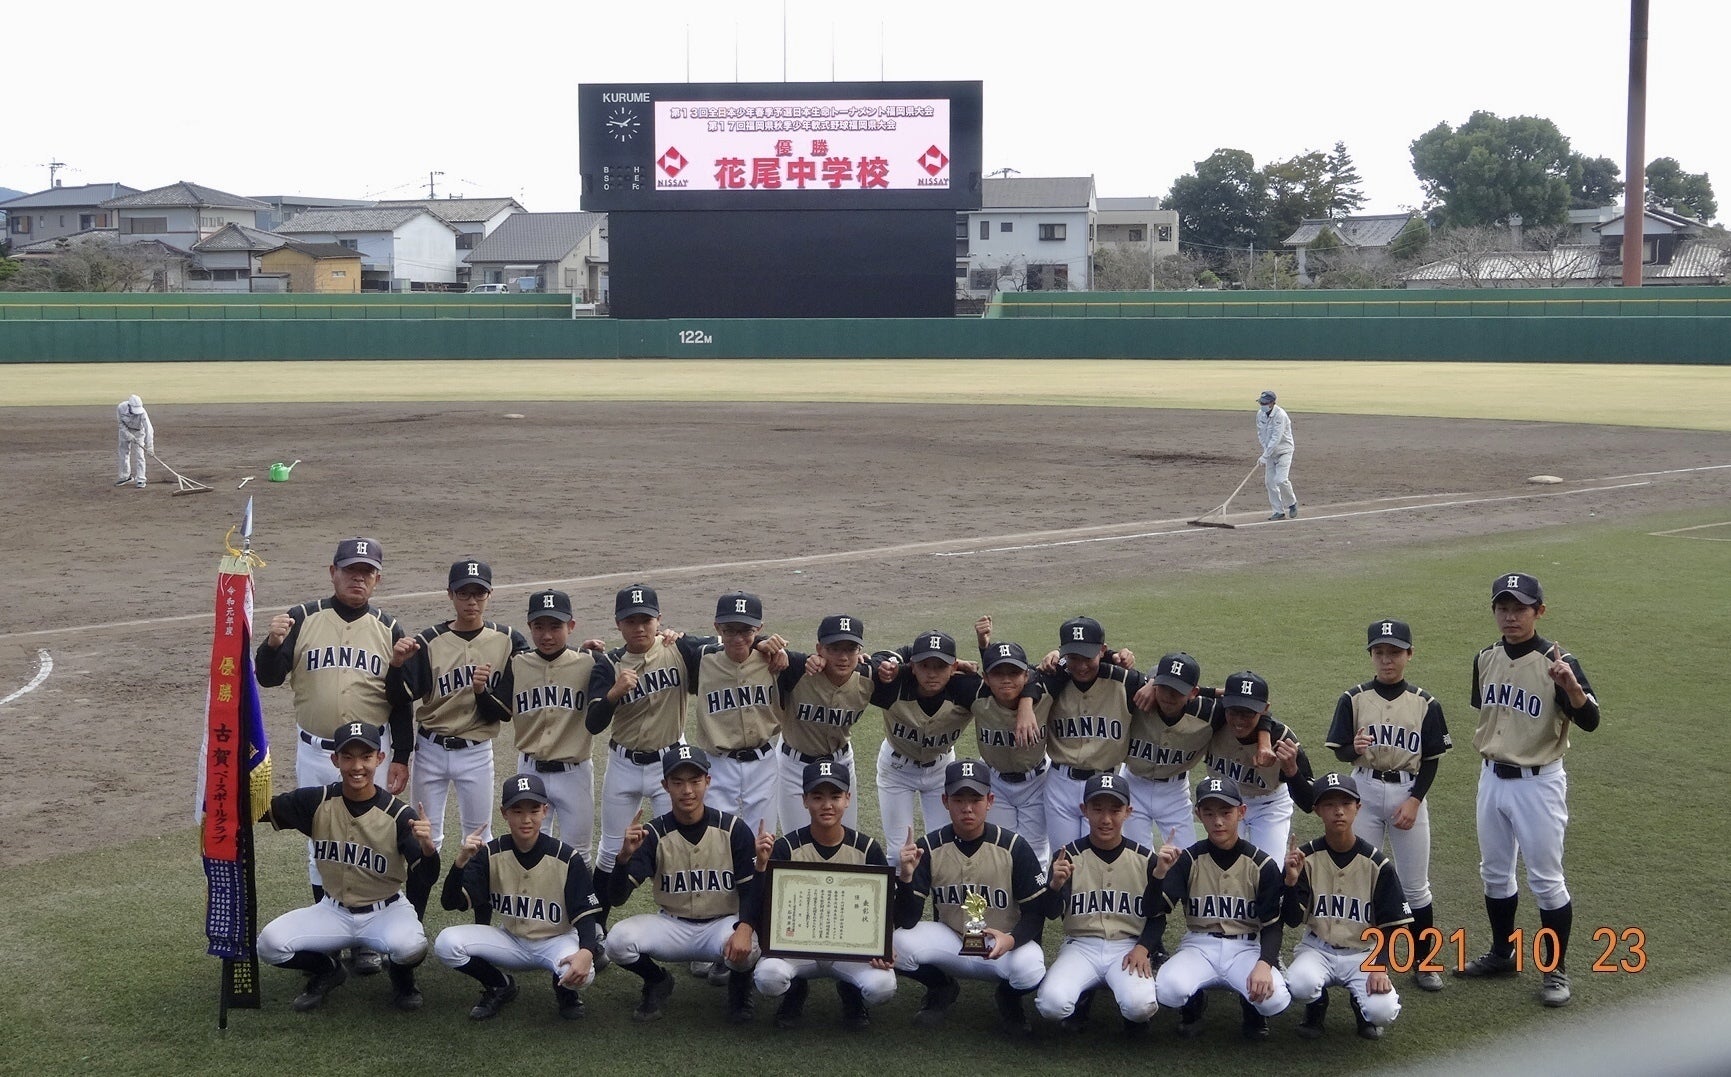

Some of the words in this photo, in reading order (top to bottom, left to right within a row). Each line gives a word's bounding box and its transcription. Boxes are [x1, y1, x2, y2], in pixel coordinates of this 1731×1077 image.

[603, 92, 650, 103] KURUME
[657, 179, 688, 187] NISSAY
[714, 156, 890, 189] 花尾中学校
[917, 178, 949, 186] NISSAY
[306, 646, 382, 677] HANAO
[217, 655, 236, 702] 優勝
[438, 665, 501, 697] HANO
[515, 685, 585, 714] HANAO
[893, 722, 961, 748] HANAO
[1053, 716, 1122, 740] HANAO
[1128, 738, 1200, 766] HANAO
[313, 839, 388, 874] HANAO
[661, 870, 736, 894] HANAO
[490, 893, 562, 925] HANAO
[1070, 889, 1145, 917] HANAO
